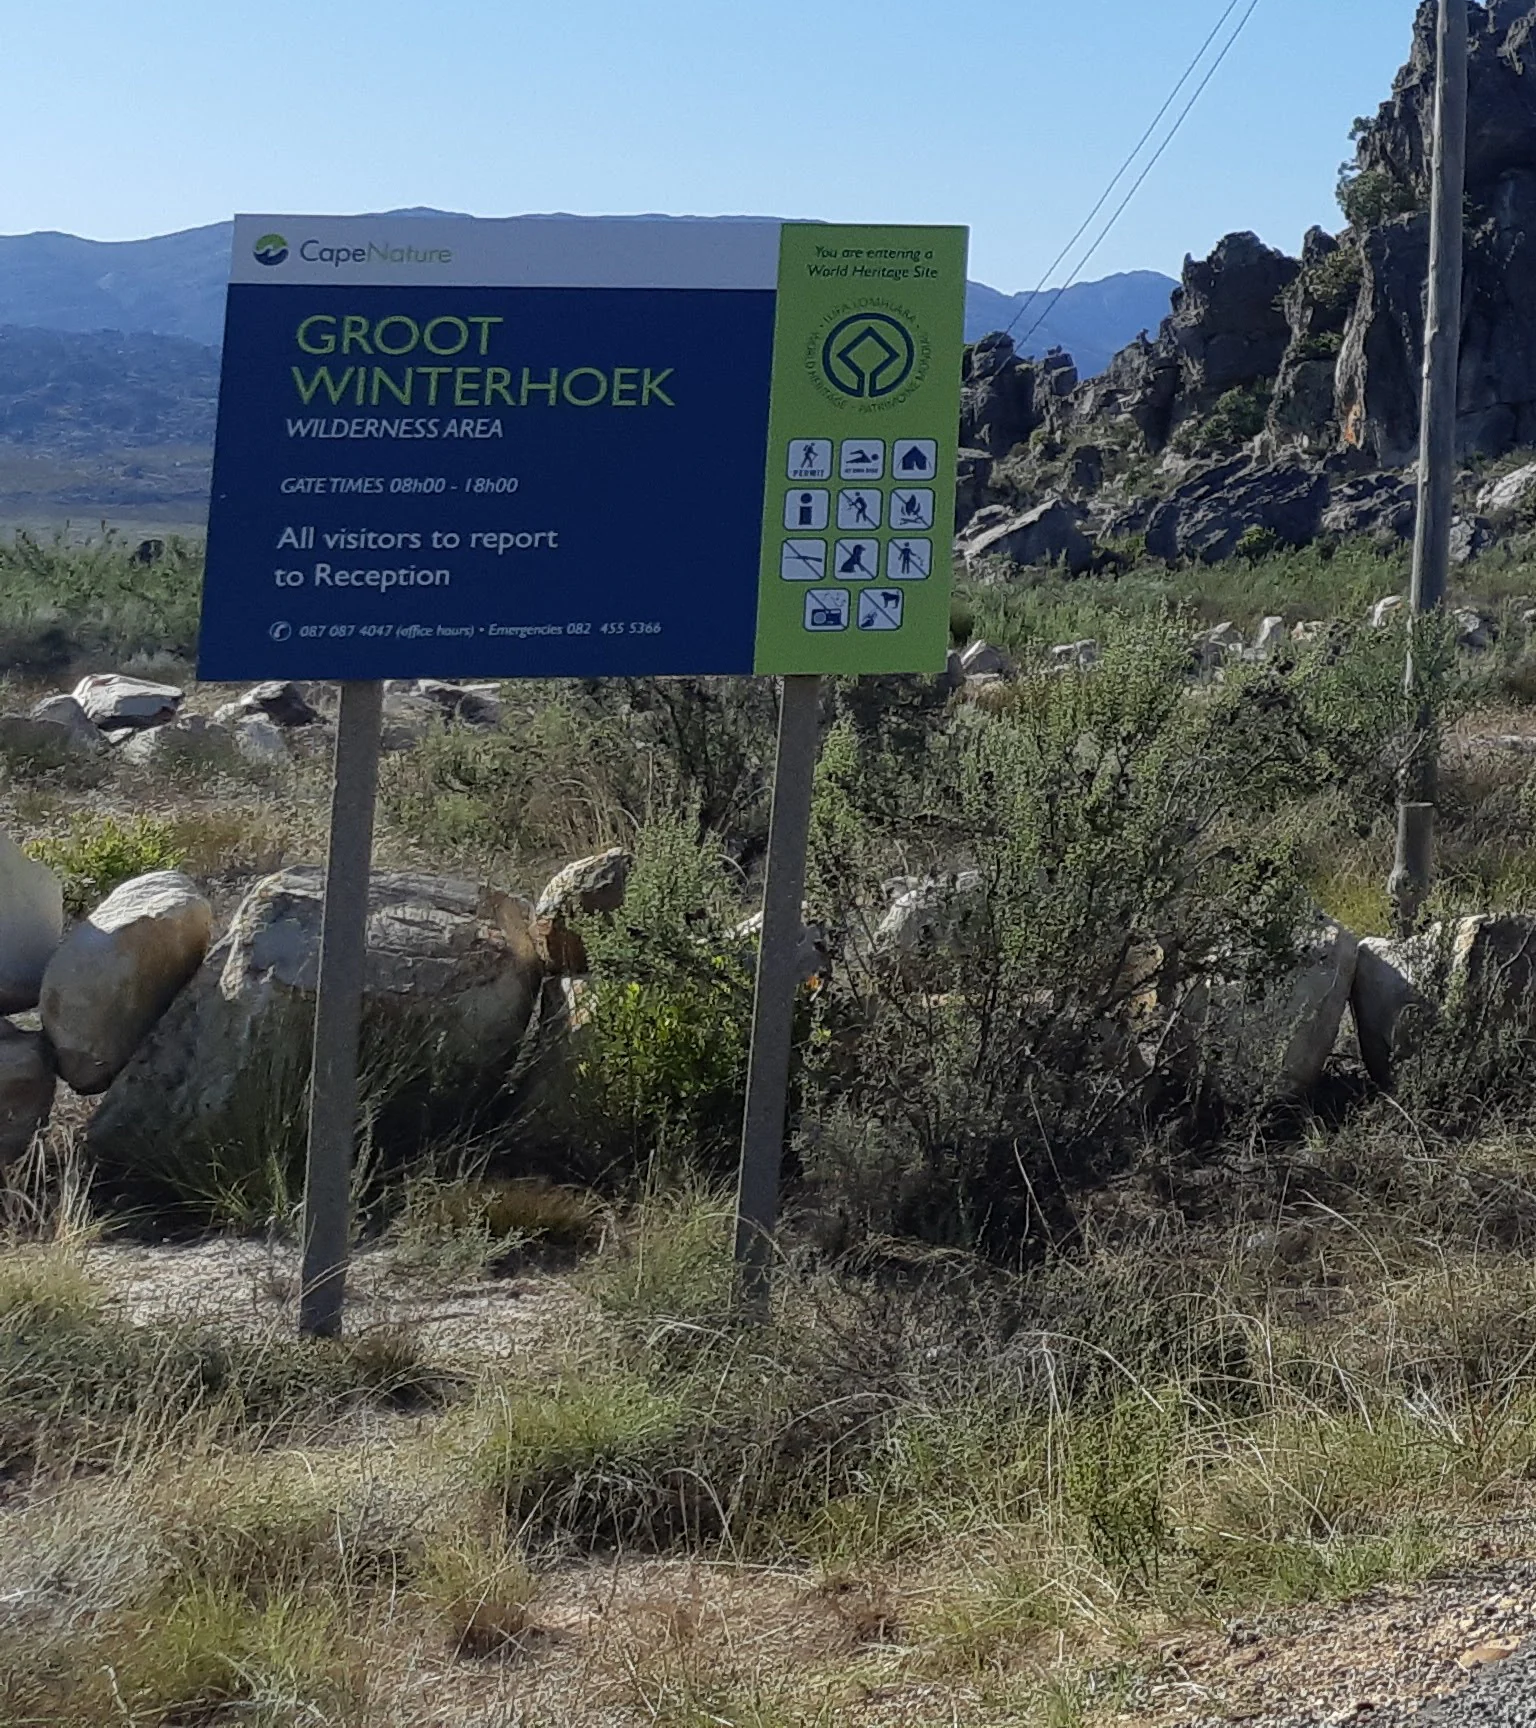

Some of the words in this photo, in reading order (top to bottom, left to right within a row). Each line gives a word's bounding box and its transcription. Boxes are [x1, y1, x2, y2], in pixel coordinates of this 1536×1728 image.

[300, 239, 452, 267] CapeNature
[815, 246, 837, 258] You
[842, 249, 863, 259] are
[866, 248, 920, 262] entering
[925, 250, 933, 259] a
[807, 264, 848, 278] World
[852, 265, 910, 281] Heritage
[914, 265, 938, 279] Site
[296, 315, 504, 355] GROOT
[291, 366, 676, 407] WINTERHOEK
[286, 418, 441, 439] WILDERNESS
[442, 418, 504, 439] AREA
[280, 477, 327, 494] GATE
[330, 477, 384, 494] TIMES
[389, 477, 446, 494] 08h00
[464, 477, 519, 494] 18h00
[276, 526, 315, 549] All
[322, 528, 422, 549] visitors
[432, 530, 461, 549] to
[469, 530, 559, 555] report
[274, 568, 305, 587] to
[314, 563, 450, 592] Reception
[300, 625, 327, 638] 087
[329, 625, 356, 638] 087
[359, 624, 394, 637] 4047
[396, 624, 434, 639] (office
[436, 624, 475, 639] hours)
[488, 622, 564, 639] Emergencies
[566, 622, 592, 635] 082
[599, 622, 625, 635] 455
[628, 622, 662, 635] 5366
